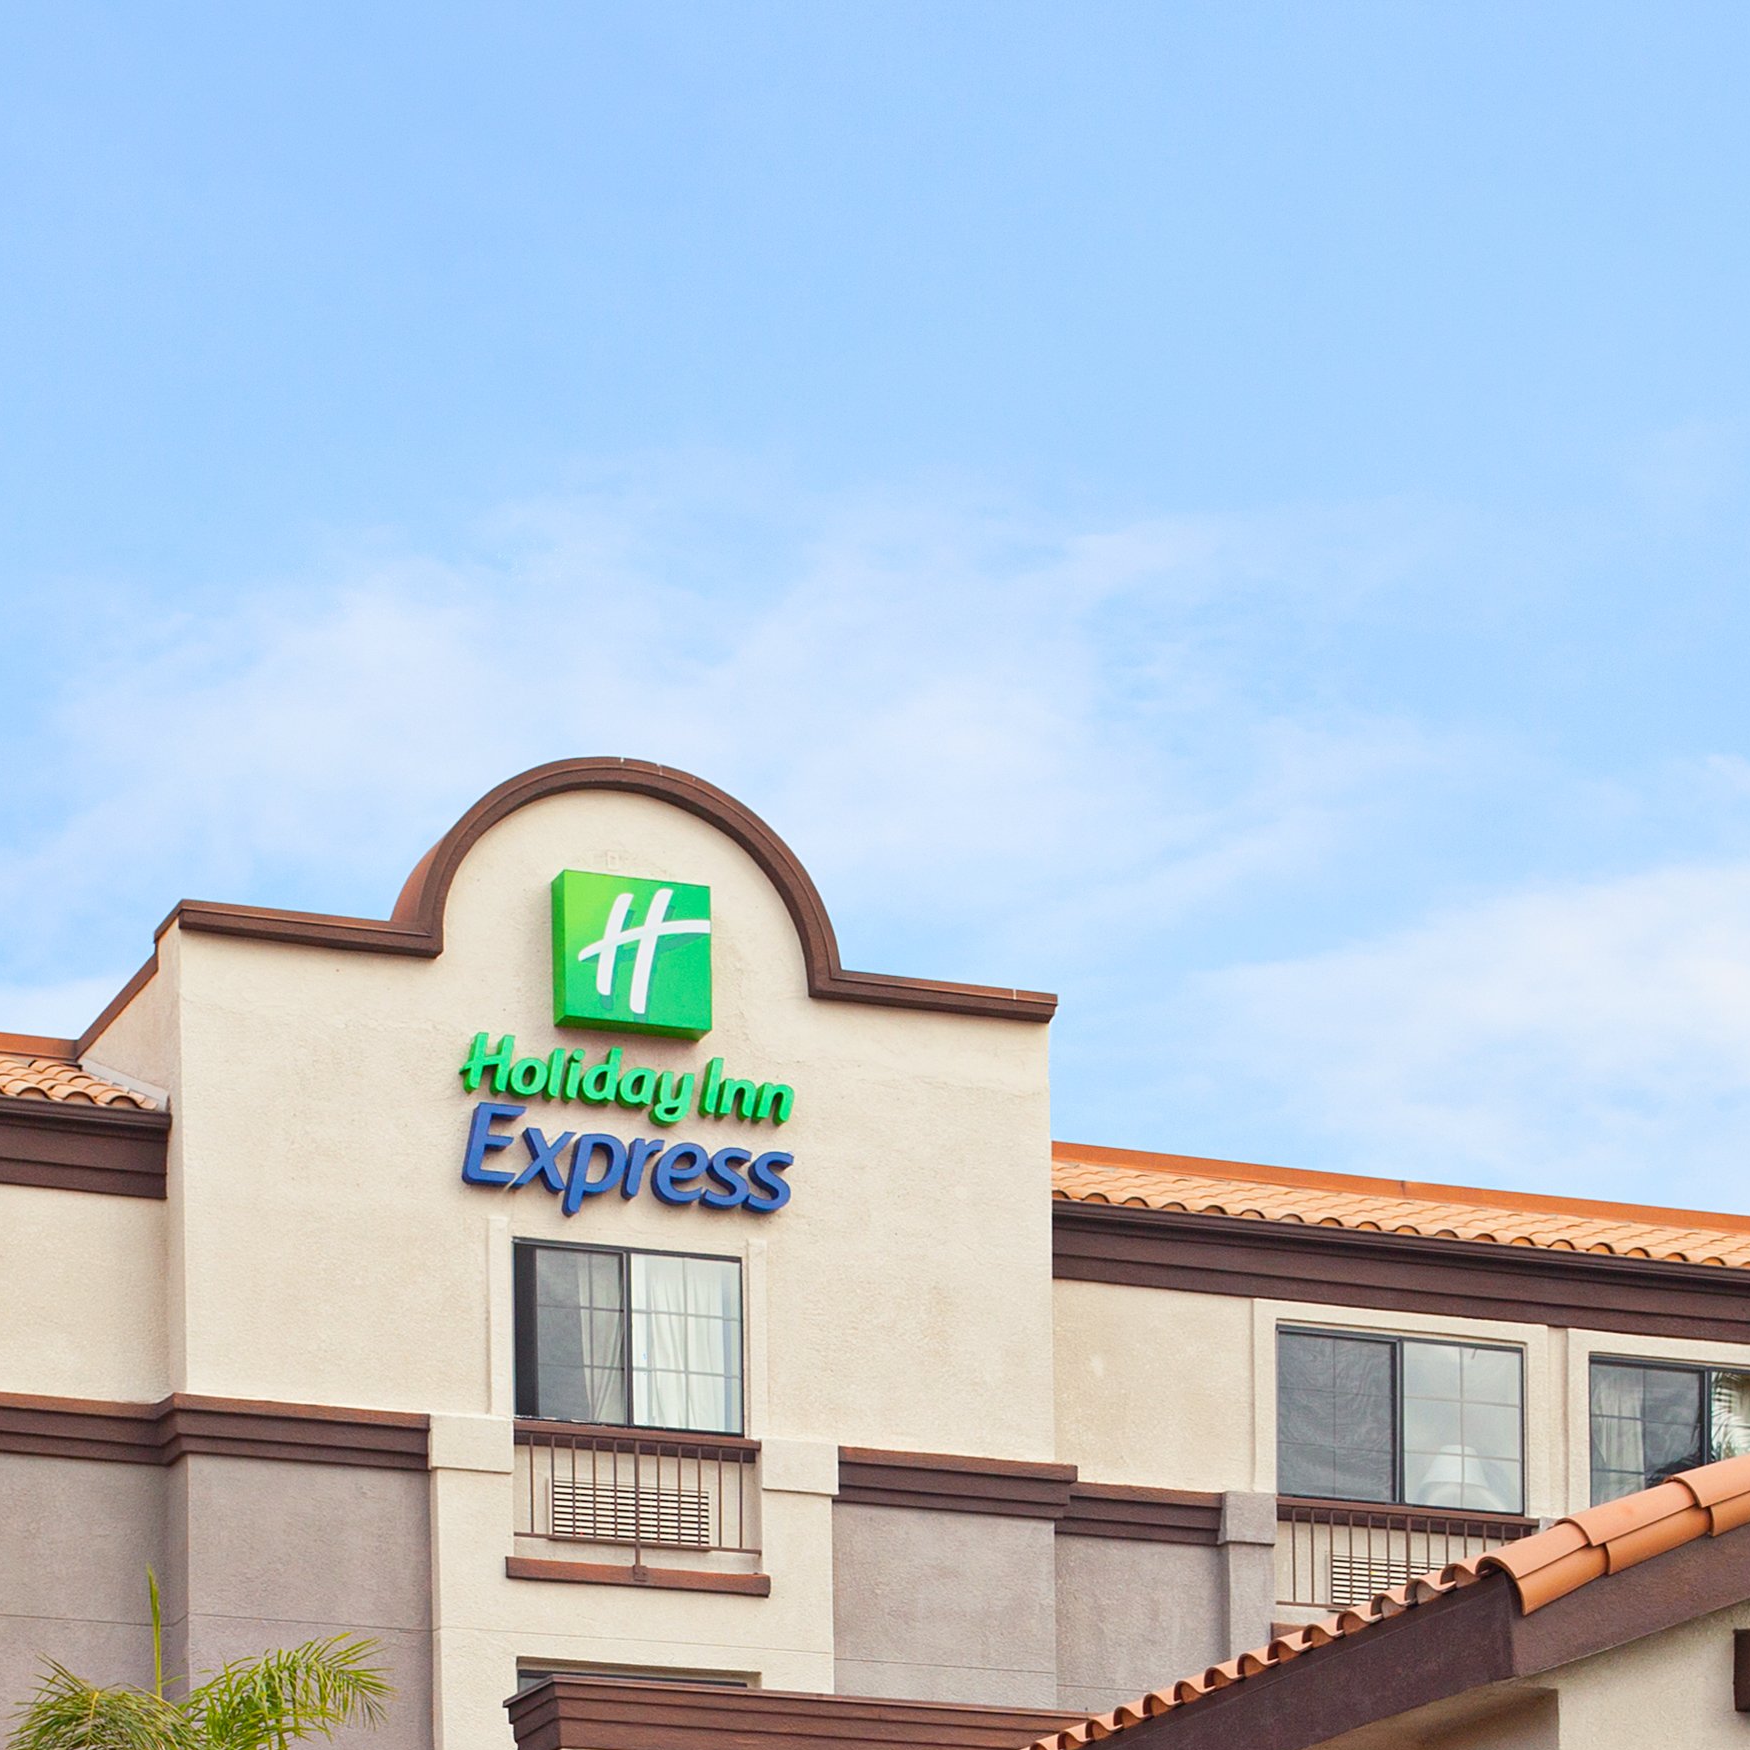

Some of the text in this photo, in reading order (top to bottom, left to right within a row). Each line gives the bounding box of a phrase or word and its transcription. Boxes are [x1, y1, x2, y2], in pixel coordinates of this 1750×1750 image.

[459, 1032, 795, 1127] Holiday Inn
[462, 1101, 795, 1216] Express
